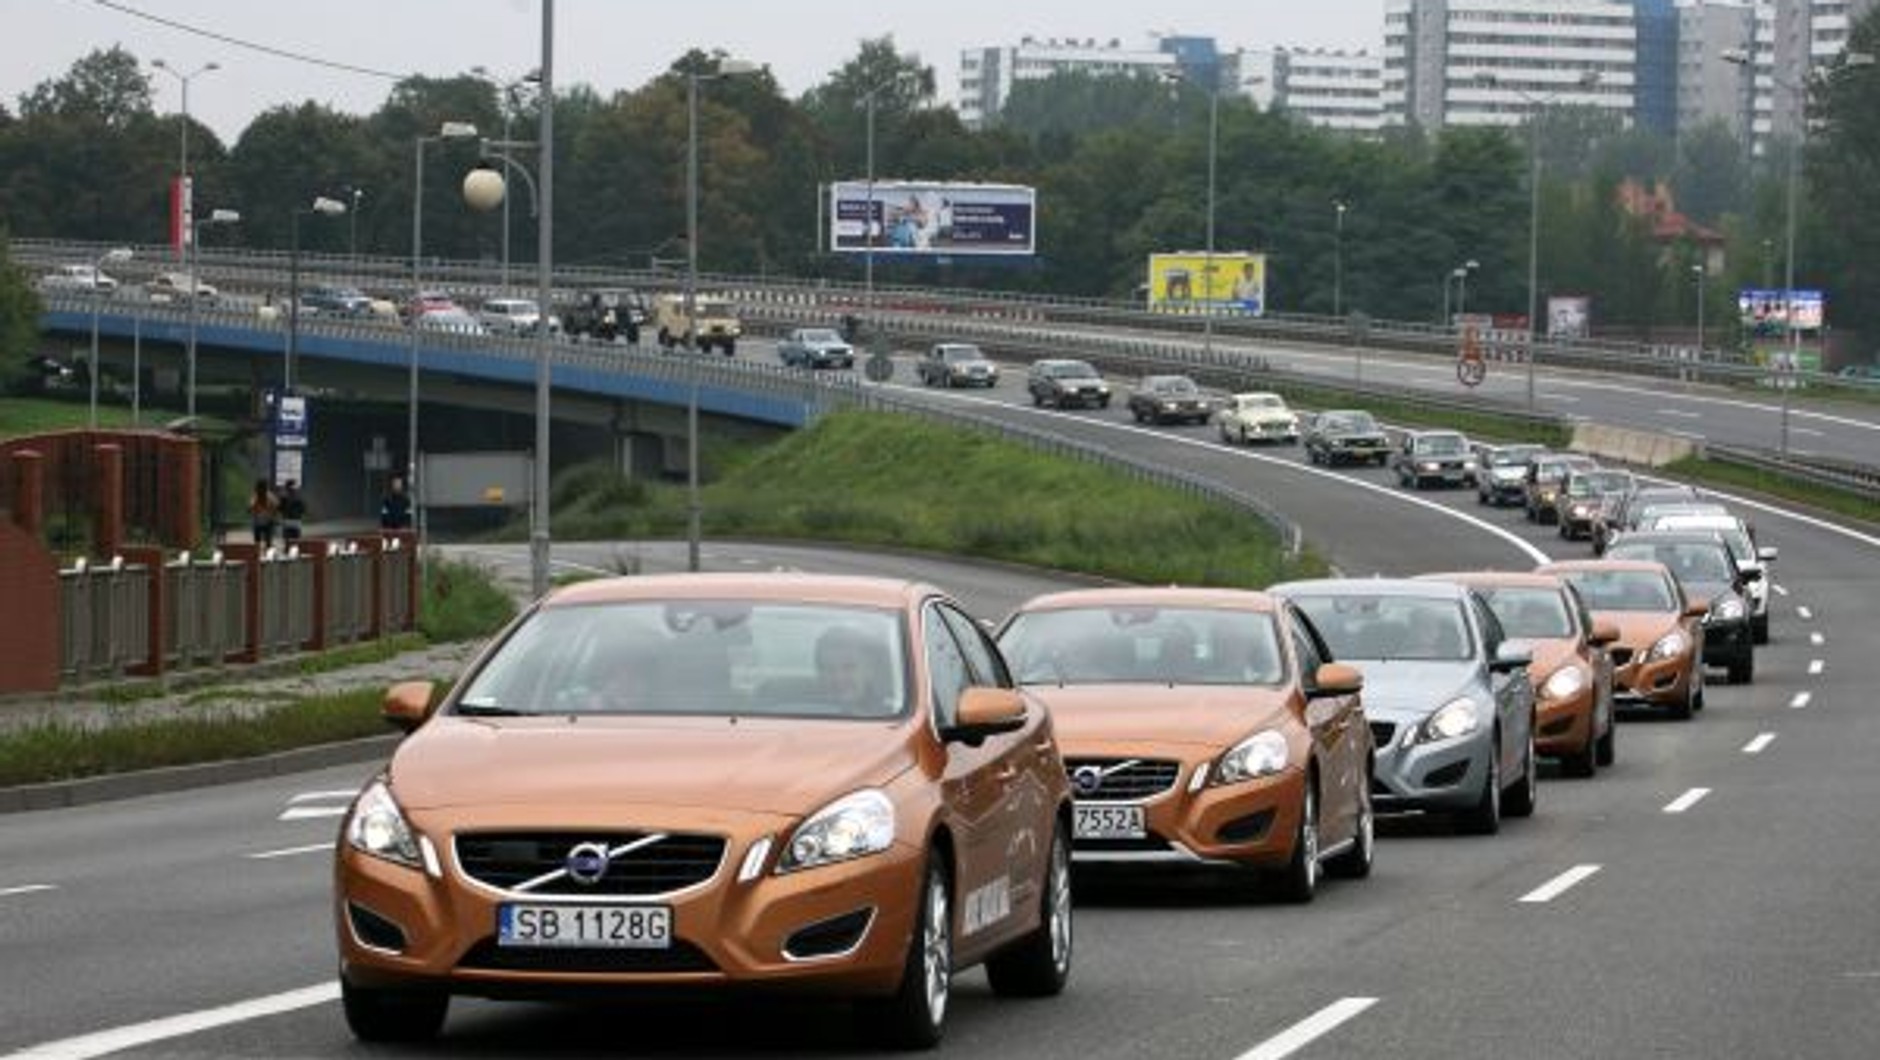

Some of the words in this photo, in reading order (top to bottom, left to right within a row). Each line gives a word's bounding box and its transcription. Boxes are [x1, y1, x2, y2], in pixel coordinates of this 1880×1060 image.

[1077, 808, 1142, 831] 7552A
[517, 909, 560, 939] SB
[574, 909, 666, 940] 1128G
